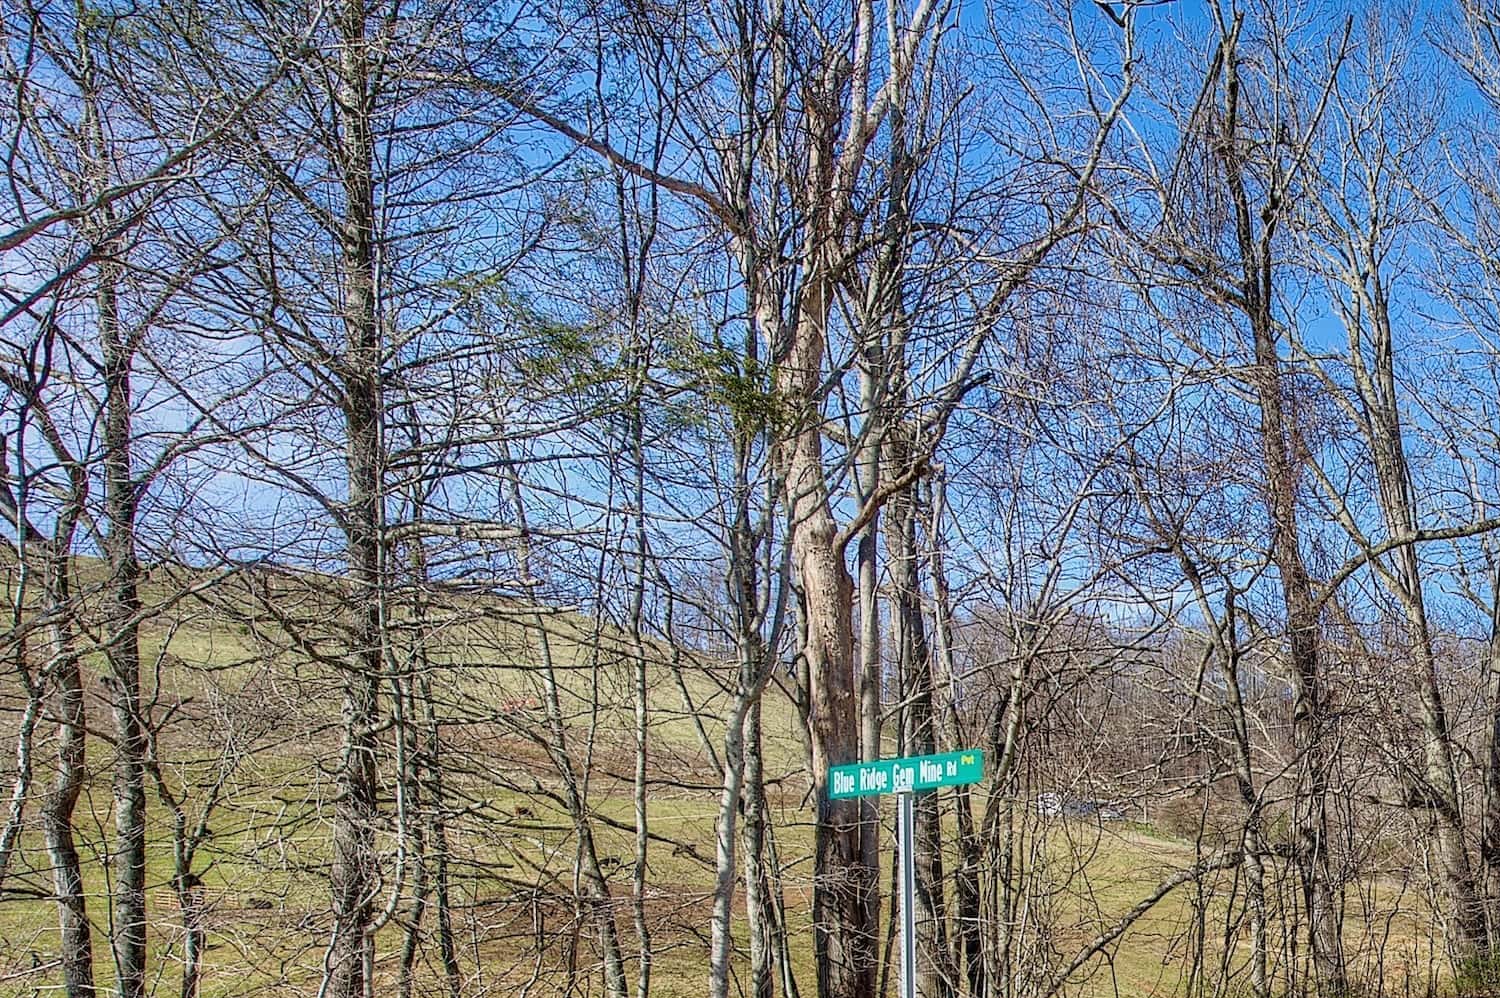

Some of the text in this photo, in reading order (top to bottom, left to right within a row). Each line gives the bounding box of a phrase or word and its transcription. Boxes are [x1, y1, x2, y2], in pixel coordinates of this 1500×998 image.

[834, 760, 957, 794] Blue Ridge Gem Mine Rd
